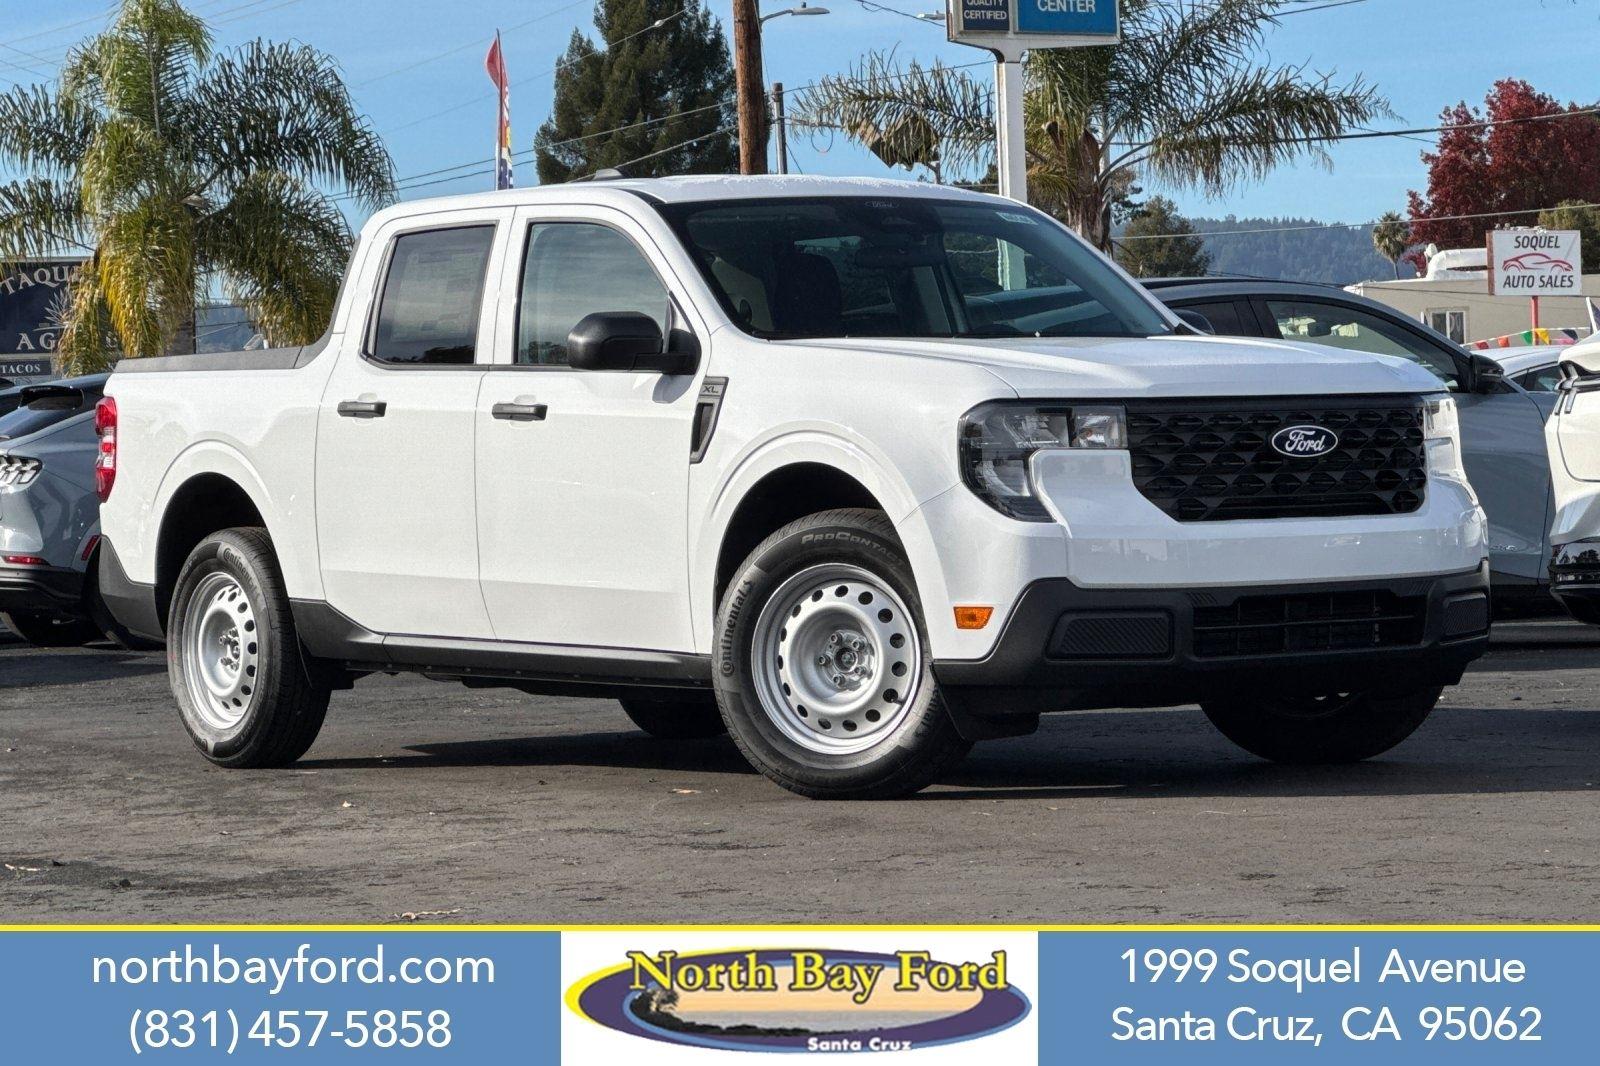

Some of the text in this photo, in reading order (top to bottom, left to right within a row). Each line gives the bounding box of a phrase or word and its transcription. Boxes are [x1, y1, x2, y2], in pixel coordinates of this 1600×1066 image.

[1037, 0, 1096, 13] CENTER
[963, 10, 1007, 20] CERTIFIED
[1514, 235, 1560, 250] SOQUEL
[1503, 275, 1574, 288] AUTO SALES
[1, 363, 41, 374] TACOS
[703, 385, 719, 394] XL
[1285, 429, 1326, 452] Ford
